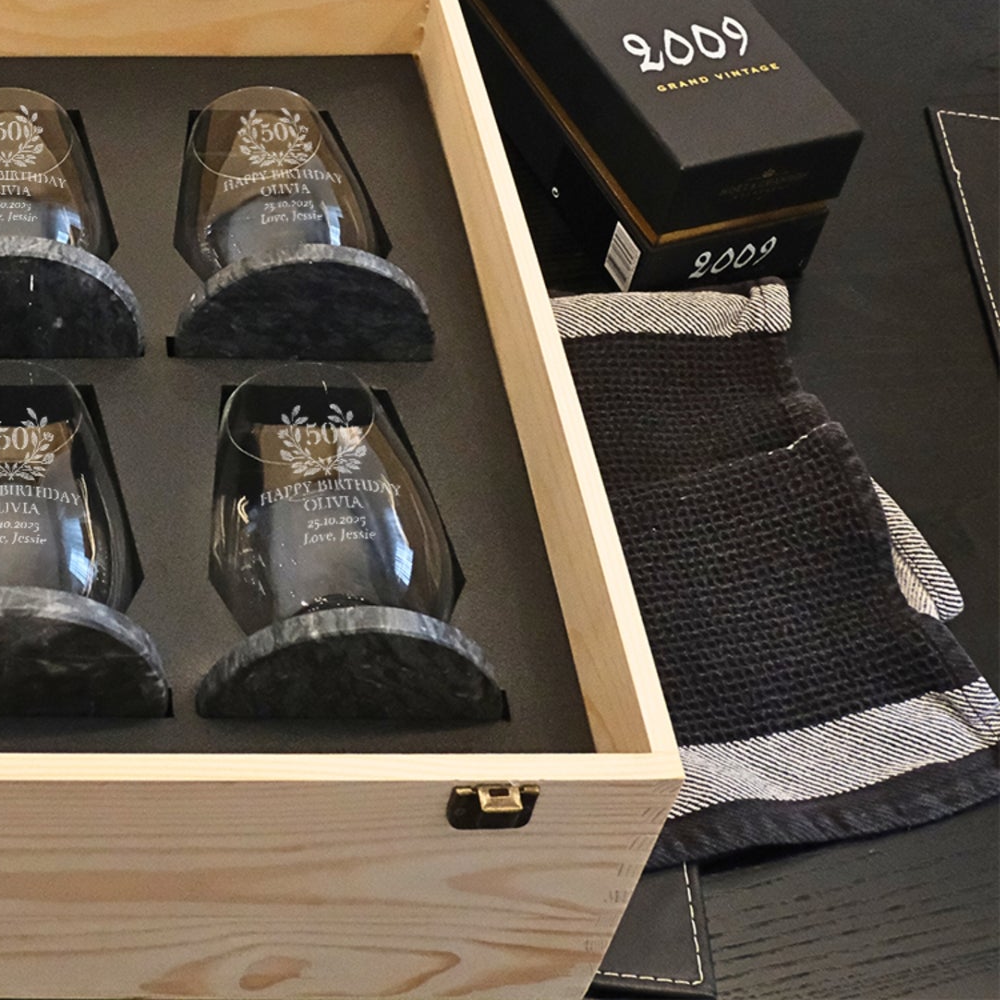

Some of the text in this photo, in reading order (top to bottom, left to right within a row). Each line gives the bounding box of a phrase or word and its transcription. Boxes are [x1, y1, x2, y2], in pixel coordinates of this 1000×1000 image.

[622, 15, 749, 73] 2009
[656, 62, 781, 93] GRAND VINTAGE
[260, 121, 288, 143] 50
[260, 183, 311, 197] OLIVIA
[688, 235, 778, 280] 2009
[0, 484, 81, 506] BIRTHDAY
[260, 480, 312, 507] HAPPY
[303, 495, 364, 512] OLIVIA
